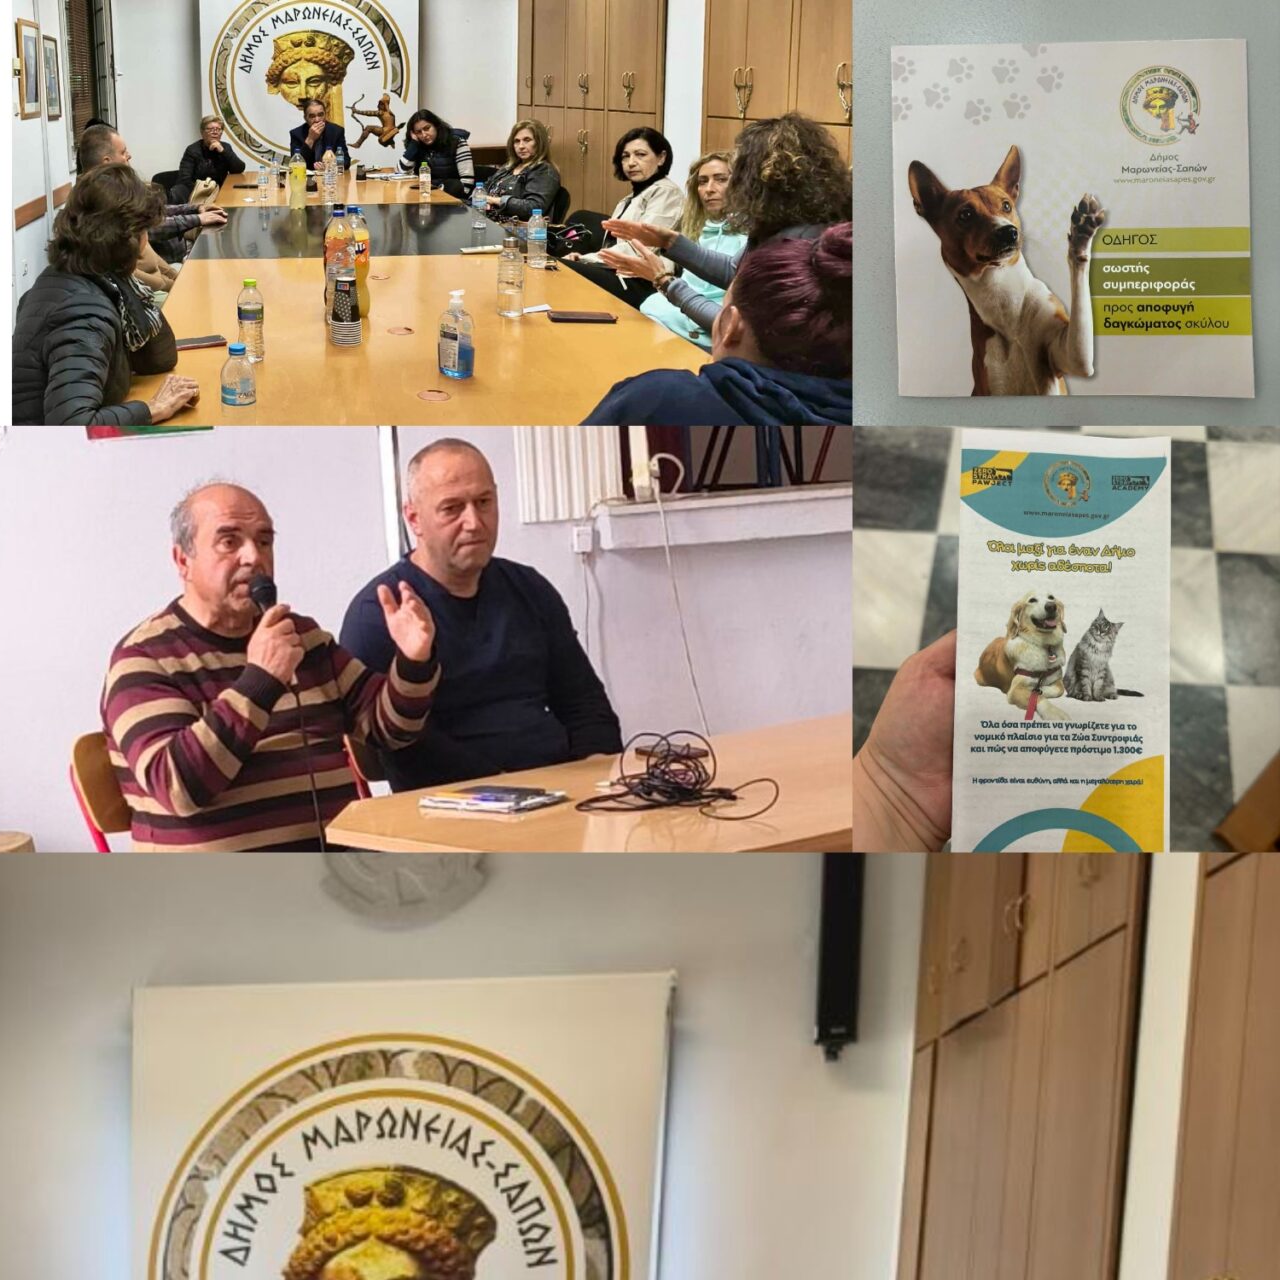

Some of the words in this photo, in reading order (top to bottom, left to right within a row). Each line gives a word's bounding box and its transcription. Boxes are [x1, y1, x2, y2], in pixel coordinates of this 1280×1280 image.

[1149, 153, 1179, 162] Δήμος
[1102, 234, 1158, 246] ΟΔΗΓΟΣ
[1102, 262, 1150, 275] σωστής
[1102, 278, 1196, 292] συμπεριφοράς
[1103, 304, 1133, 315] προς
[1136, 301, 1195, 315] αποφυγή
[1103, 317, 1182, 331] δαγκώματος
[1184, 317, 1230, 329] σκύλου
[1046, 544, 1067, 557] για
[1068, 543, 1100, 556] έναν
[1100, 544, 1136, 560] Δήμο
[1011, 559, 1046, 573] χωρίς
[1047, 559, 1113, 573] αδέσποτα!
[980, 720, 1000, 729] Όλα
[1001, 721, 1018, 729] όσα
[1020, 721, 1051, 730] πρέπει
[1064, 721, 1109, 731] γνωρίζετε
[1111, 723, 1126, 731] για
[974, 732, 1006, 742] νομικό
[1007, 732, 1043, 741] πλαίσιο
[1044, 734, 1058, 742] για
[1071, 733, 1090, 741] Ζώα
[1091, 734, 1143, 744] Συντροφιάς
[970, 745, 986, 753] και
[987, 744, 1006, 754] πώς
[1020, 745, 1069, 754] αποφύγετε
[1070, 745, 1112, 755] πρόστιμο
[1113, 746, 1143, 754] 1.300€
